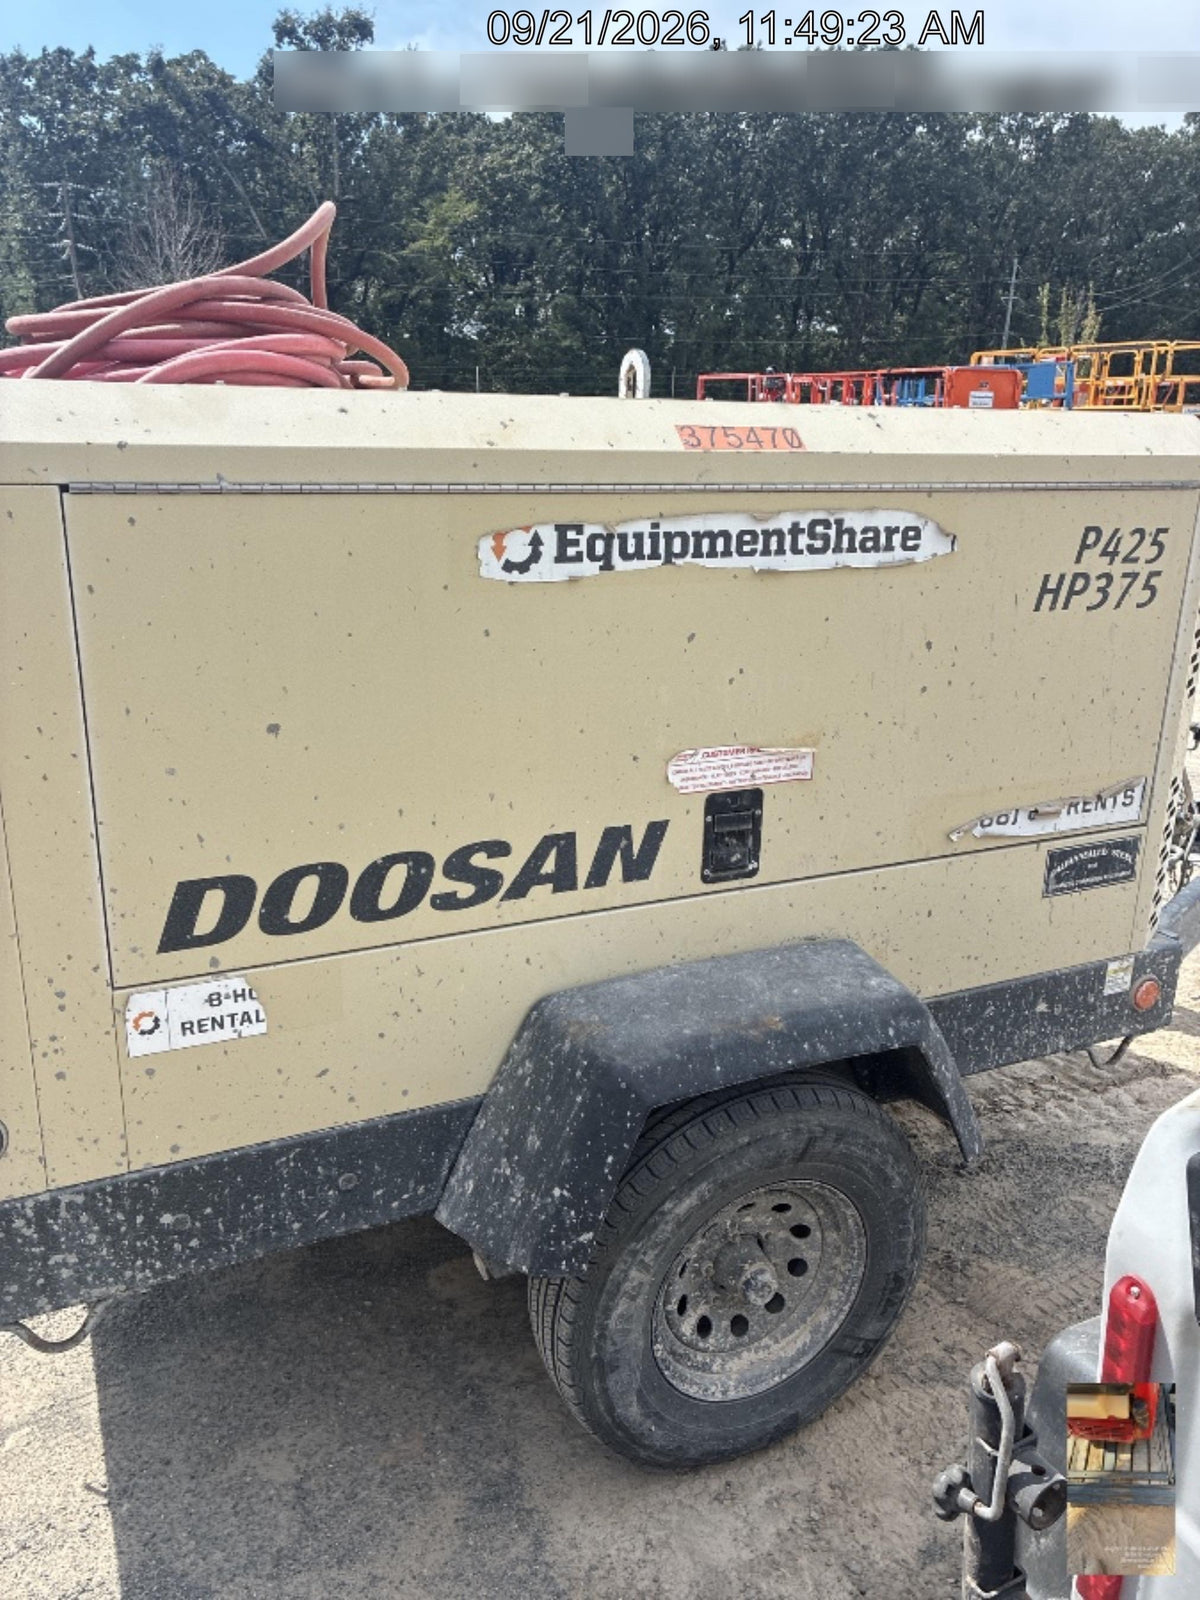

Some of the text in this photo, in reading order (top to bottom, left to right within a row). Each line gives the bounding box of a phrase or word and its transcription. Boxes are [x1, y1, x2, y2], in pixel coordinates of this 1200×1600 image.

[680, 426, 803, 449] 375470
[554, 517, 922, 571] EquipmentShare
[1074, 525, 1170, 566] P425
[1033, 570, 1163, 612] HP375
[156, 819, 670, 954] DOOSAN
